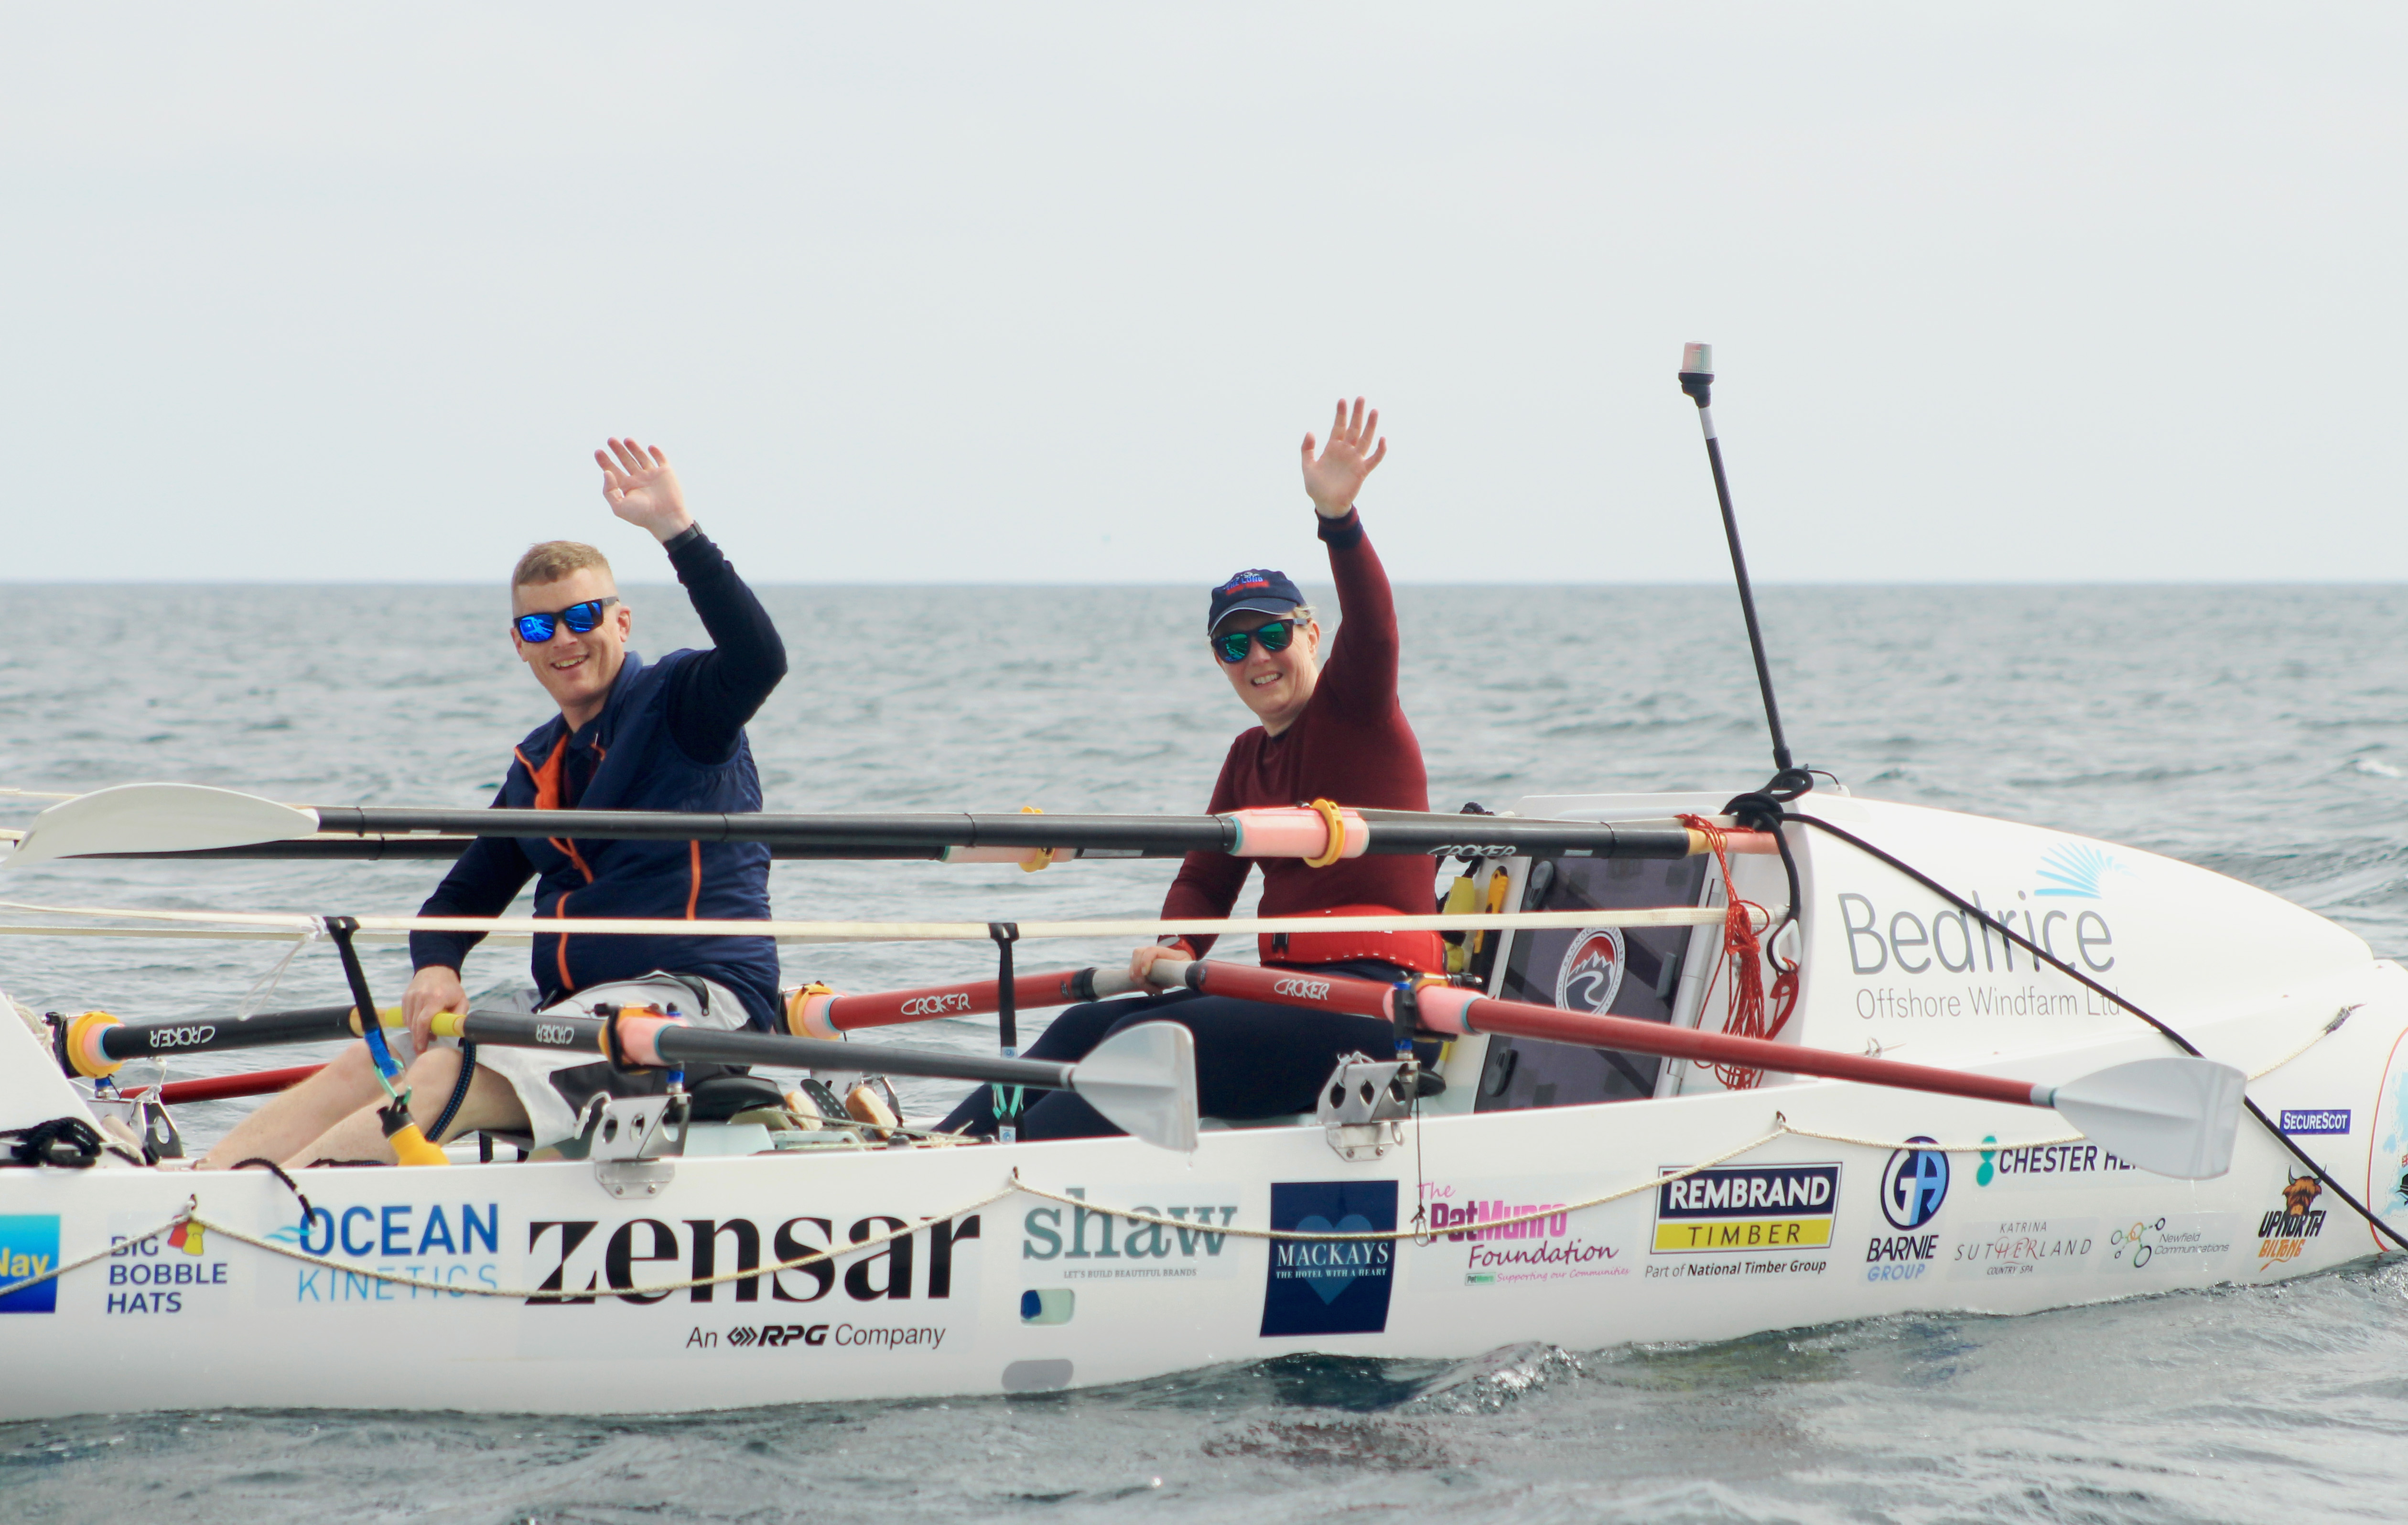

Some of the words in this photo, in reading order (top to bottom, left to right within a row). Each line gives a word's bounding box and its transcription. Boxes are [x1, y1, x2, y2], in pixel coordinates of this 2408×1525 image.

[1838, 890, 2115, 975] Beatrice
[1274, 978, 1329, 1001] CROKER
[901, 993, 971, 1016] CROKER
[1857, 987, 1961, 1020] Offshore
[1968, 985, 2078, 1017] Windfarm
[2086, 984, 2120, 1016] Ltd
[150, 1026, 215, 1048] CROKER
[536, 1024, 575, 1045] CROKER
[1999, 1146, 2097, 1174] CHESTER
[1417, 1182, 1456, 1200] The
[1670, 1177, 1830, 1210] REMBRAND
[299, 1203, 498, 1257] OCEAN
[1023, 1188, 1238, 1261] shaw
[1688, 1224, 1801, 1246] TIMBER
[2000, 1222, 2047, 1233] KATRINA
[110, 1235, 159, 1257] BIG
[1867, 1235, 1939, 1262] BARNIE
[1954, 1236, 2092, 1261] SUTHERLAND
[2155, 1244, 2230, 1255] Communications
[2160, 1233, 2201, 1243] Newfield
[525, 1214, 981, 1305] zensar
[1277, 1243, 1389, 1266] MACKAYS
[1469, 1239, 1620, 1269] Foundation
[109, 1263, 228, 1286] BOBBLE
[1088, 1270, 1113, 1278] BUILD
[1115, 1269, 1161, 1277] BEAUTIFUL
[1163, 1268, 1197, 1277] BRANDS
[1276, 1271, 1293, 1279] THE
[1295, 1270, 1323, 1278] HOTEL
[1326, 1269, 1348, 1277] WITH
[1359, 1268, 1387, 1276] HEART
[1496, 1271, 1548, 1283] Supporting
[1645, 1265, 1670, 1278] Part
[1672, 1264, 1687, 1277] of
[1687, 1262, 1741, 1277] National
[1745, 1261, 1788, 1275] Timber
[1790, 1260, 1827, 1275] Group
[1868, 1263, 1926, 1282] GROUP
[1987, 1266, 2017, 1276] COUNTRY
[2019, 1265, 2033, 1274] SPA
[298, 1264, 497, 1303] KINETICS
[107, 1292, 183, 1314] HATS
[686, 1326, 718, 1349] An
[757, 1324, 830, 1347] RPG
[835, 1323, 947, 1350] Company
